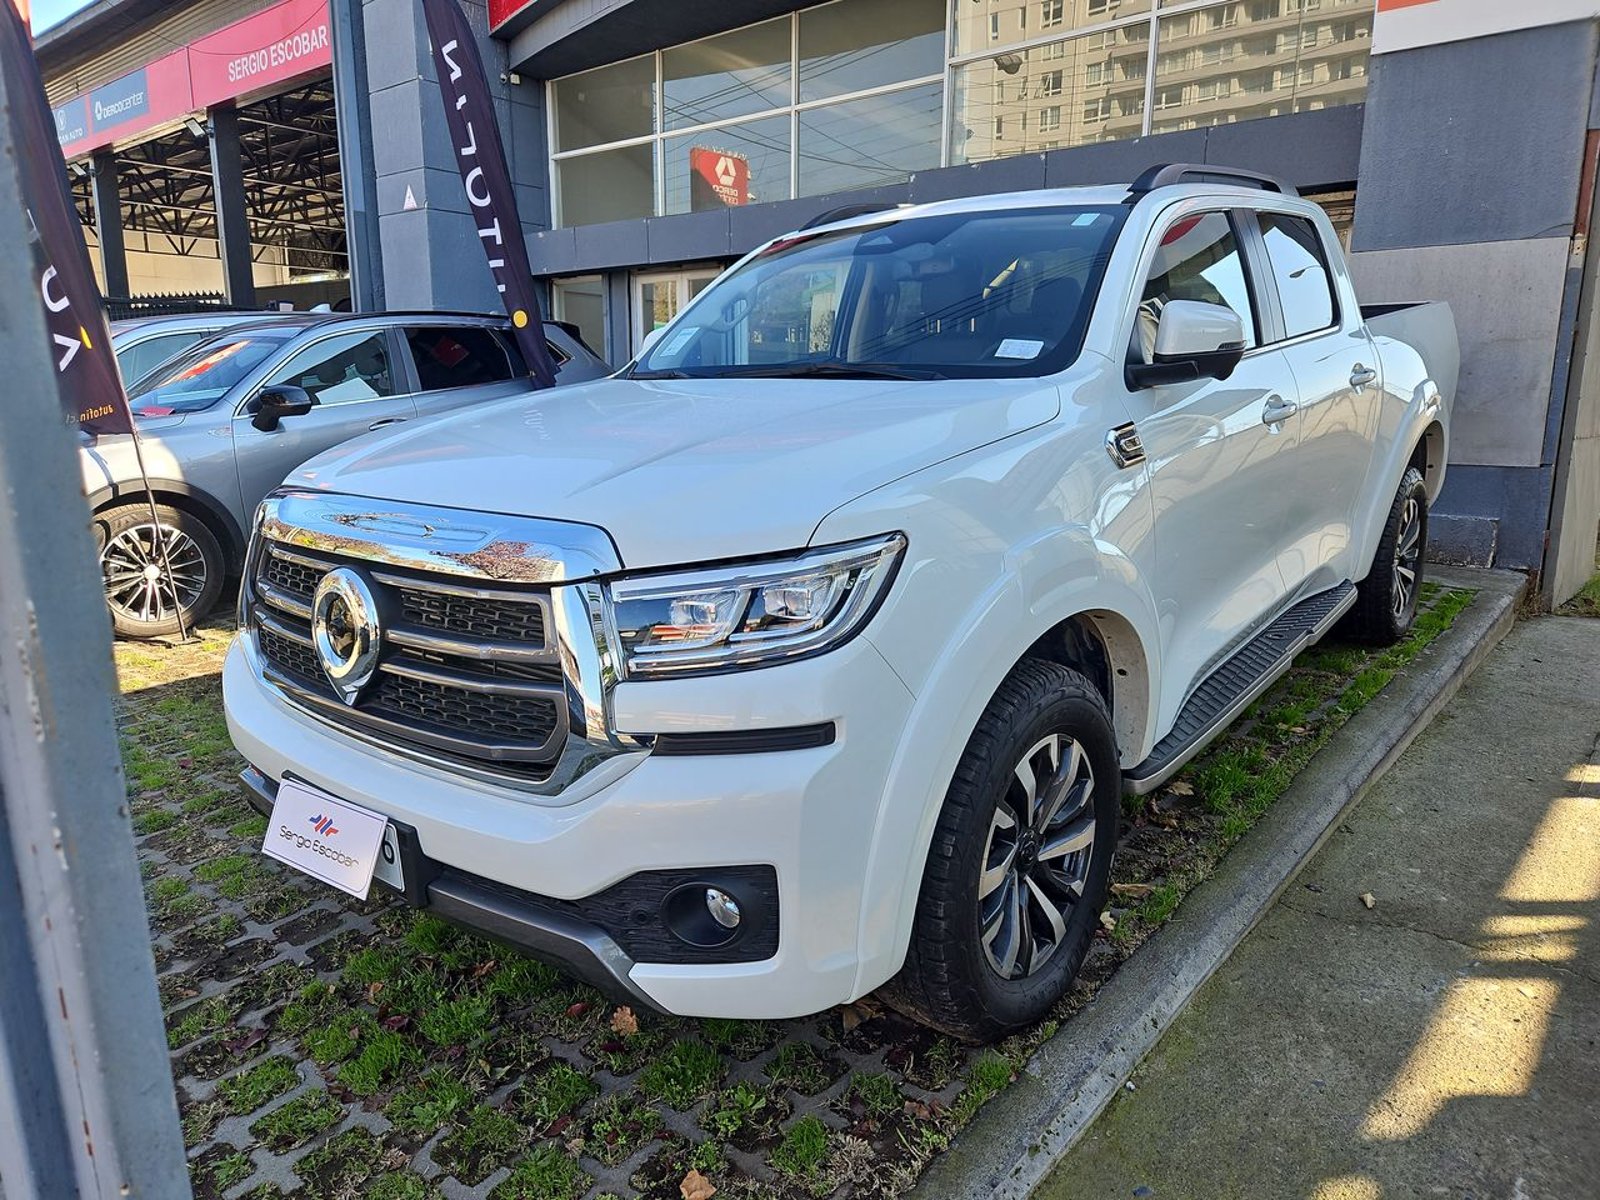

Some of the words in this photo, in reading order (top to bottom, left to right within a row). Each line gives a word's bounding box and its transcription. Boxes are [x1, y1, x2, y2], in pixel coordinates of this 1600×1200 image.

[228, 49, 268, 82] SERGIO
[270, 25, 328, 67] ESCOBAR
[312, 839, 360, 868] Escobar
